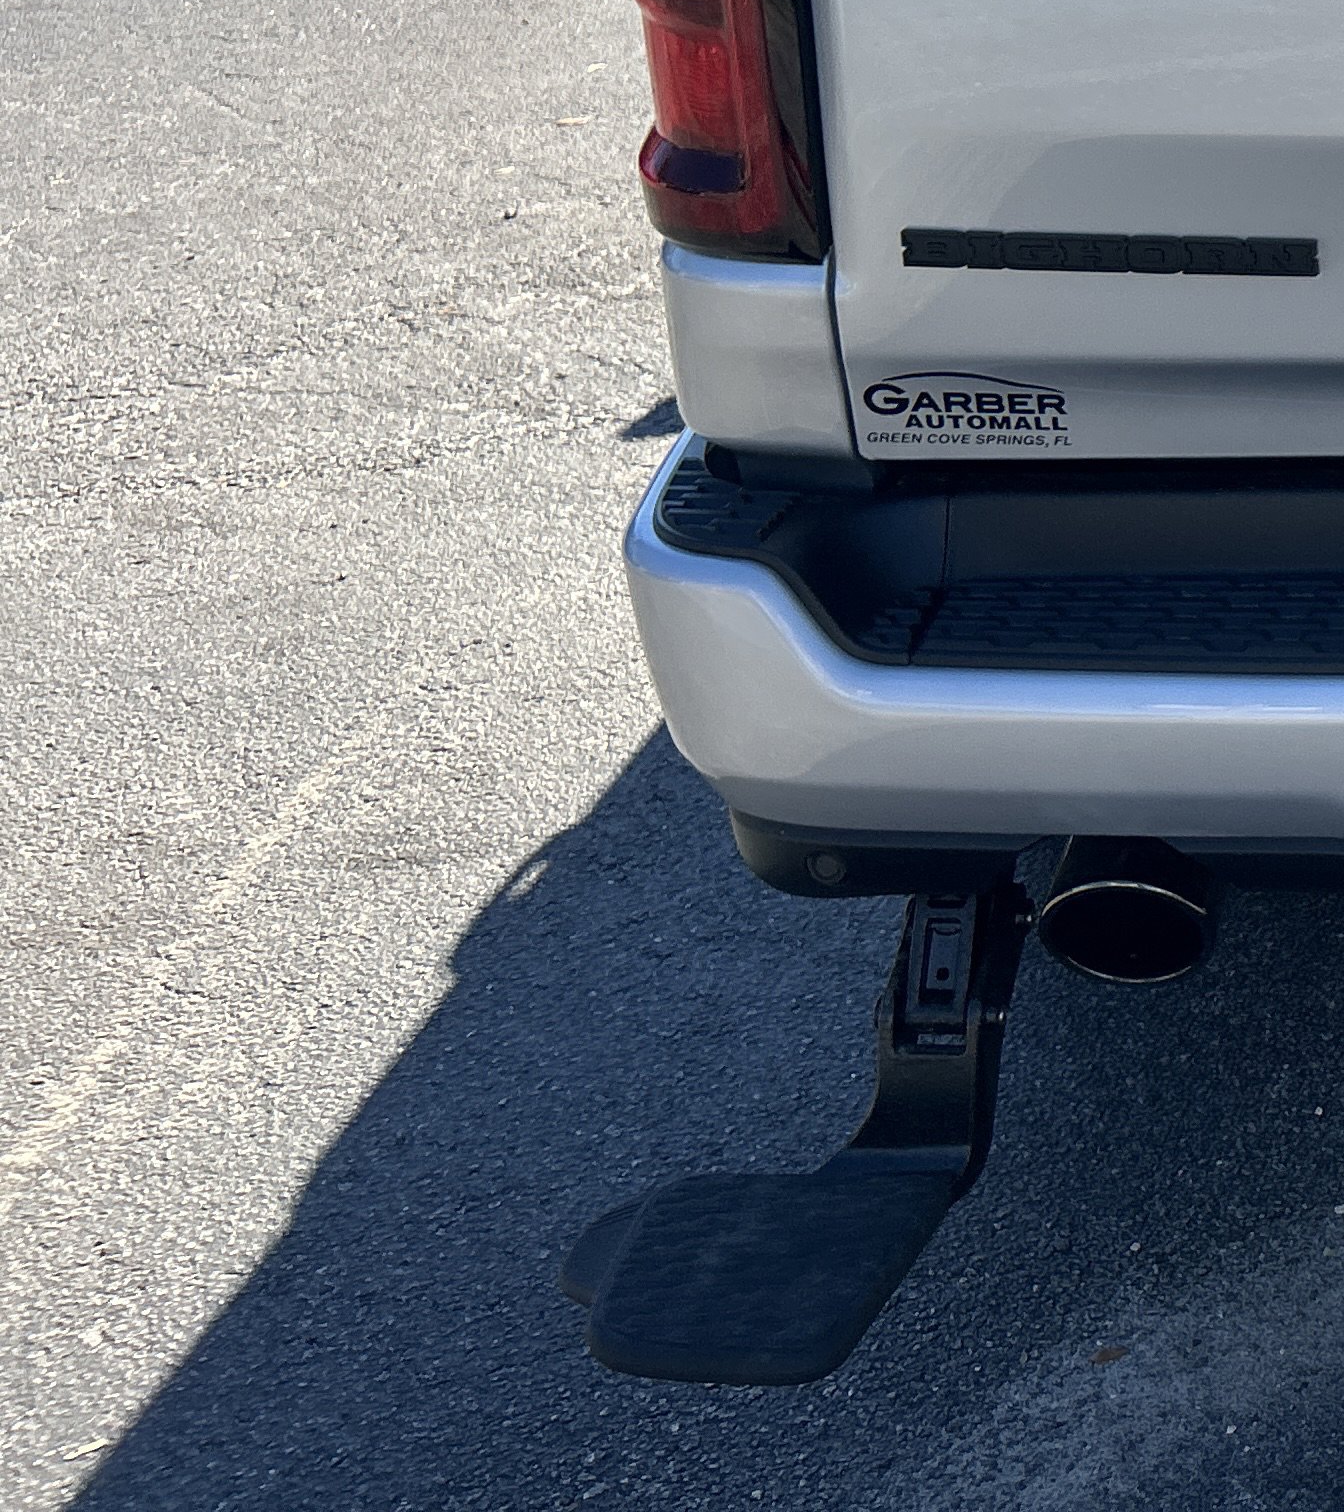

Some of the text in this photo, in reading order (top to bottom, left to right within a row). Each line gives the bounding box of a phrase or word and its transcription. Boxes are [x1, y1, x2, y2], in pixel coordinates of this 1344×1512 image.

[904, 414, 1069, 431] AUTOMALL
[866, 431, 1073, 448] GREEN COVE SPRINGS, FL
